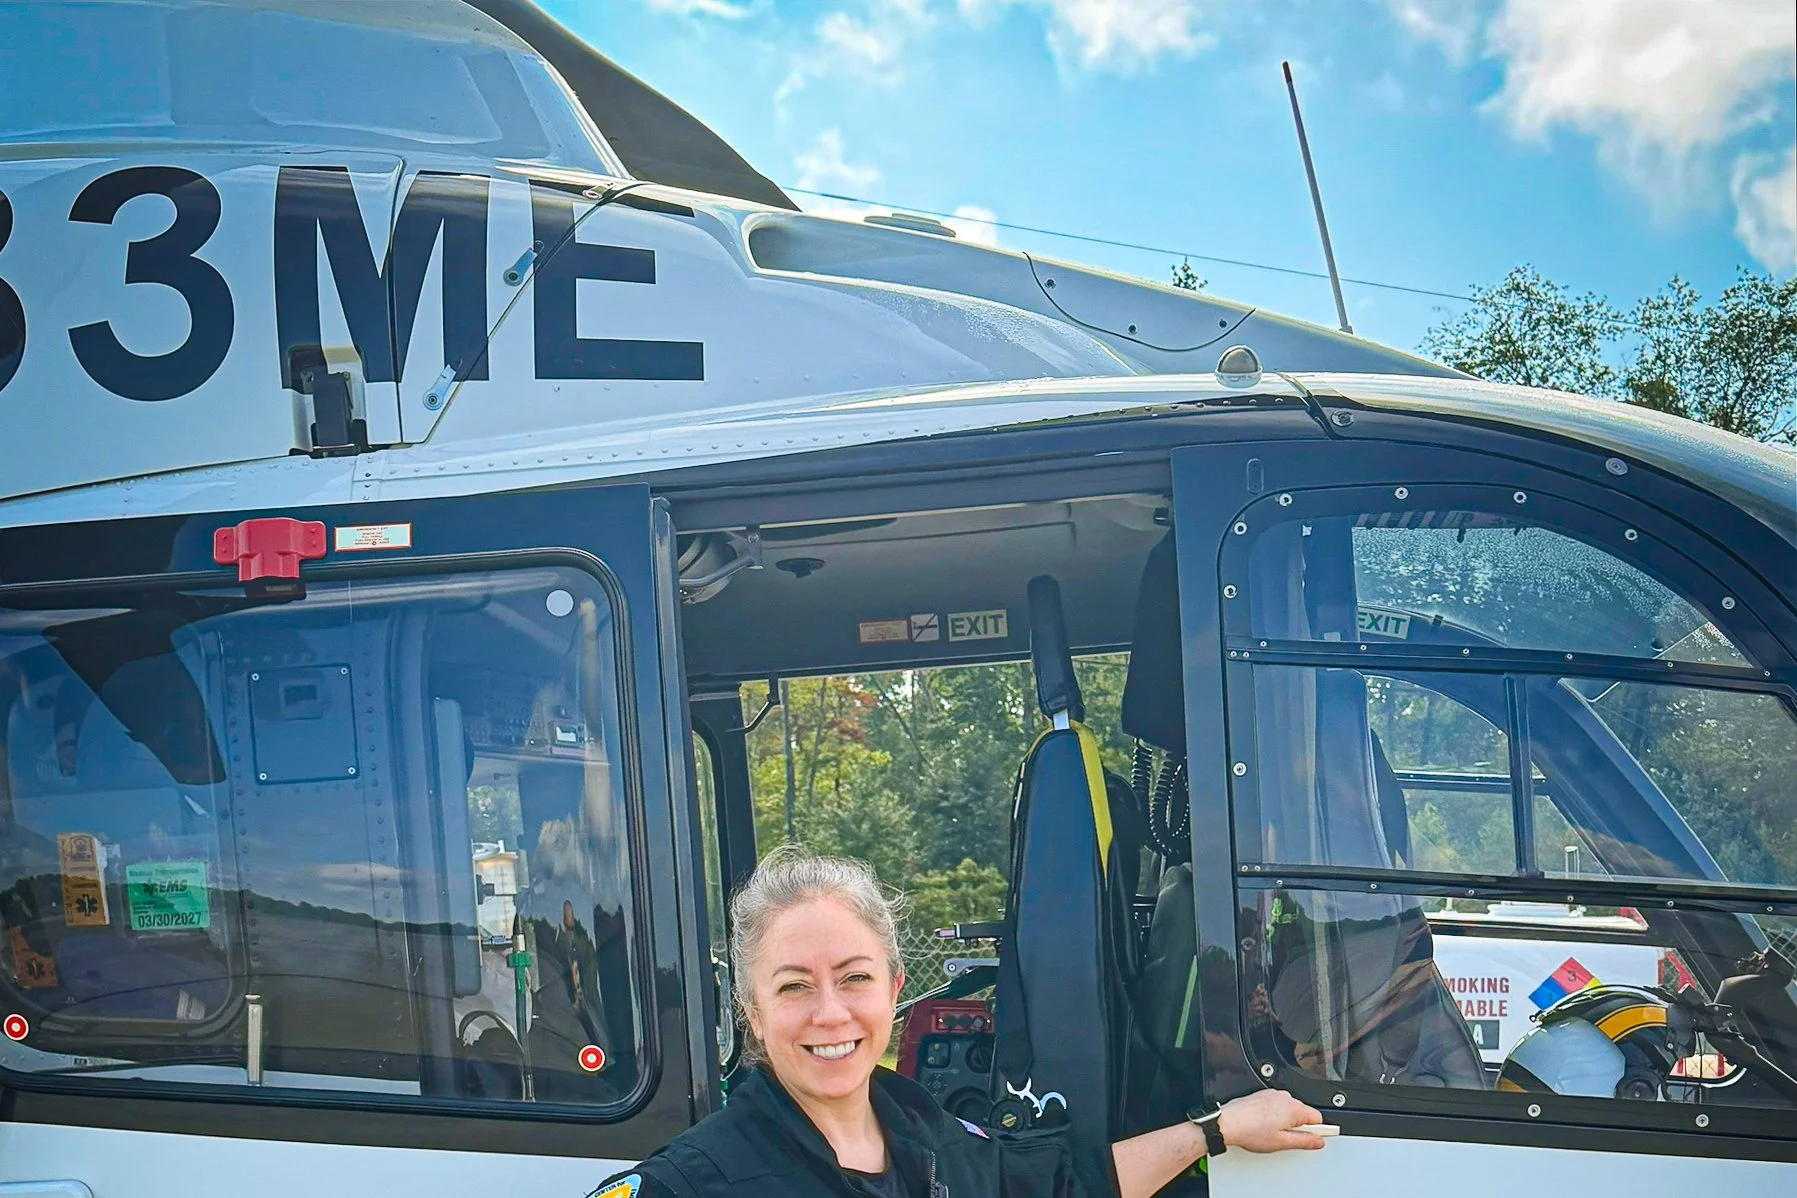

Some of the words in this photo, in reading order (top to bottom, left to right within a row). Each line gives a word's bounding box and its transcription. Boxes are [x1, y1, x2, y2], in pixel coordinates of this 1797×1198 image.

[951, 613, 1003, 638] EXIT
[1357, 611, 1407, 634] EXIT
[159, 879, 188, 894] EMS
[137, 911, 202, 929] 03/30/2027
[1567, 970, 1577, 983] 3
